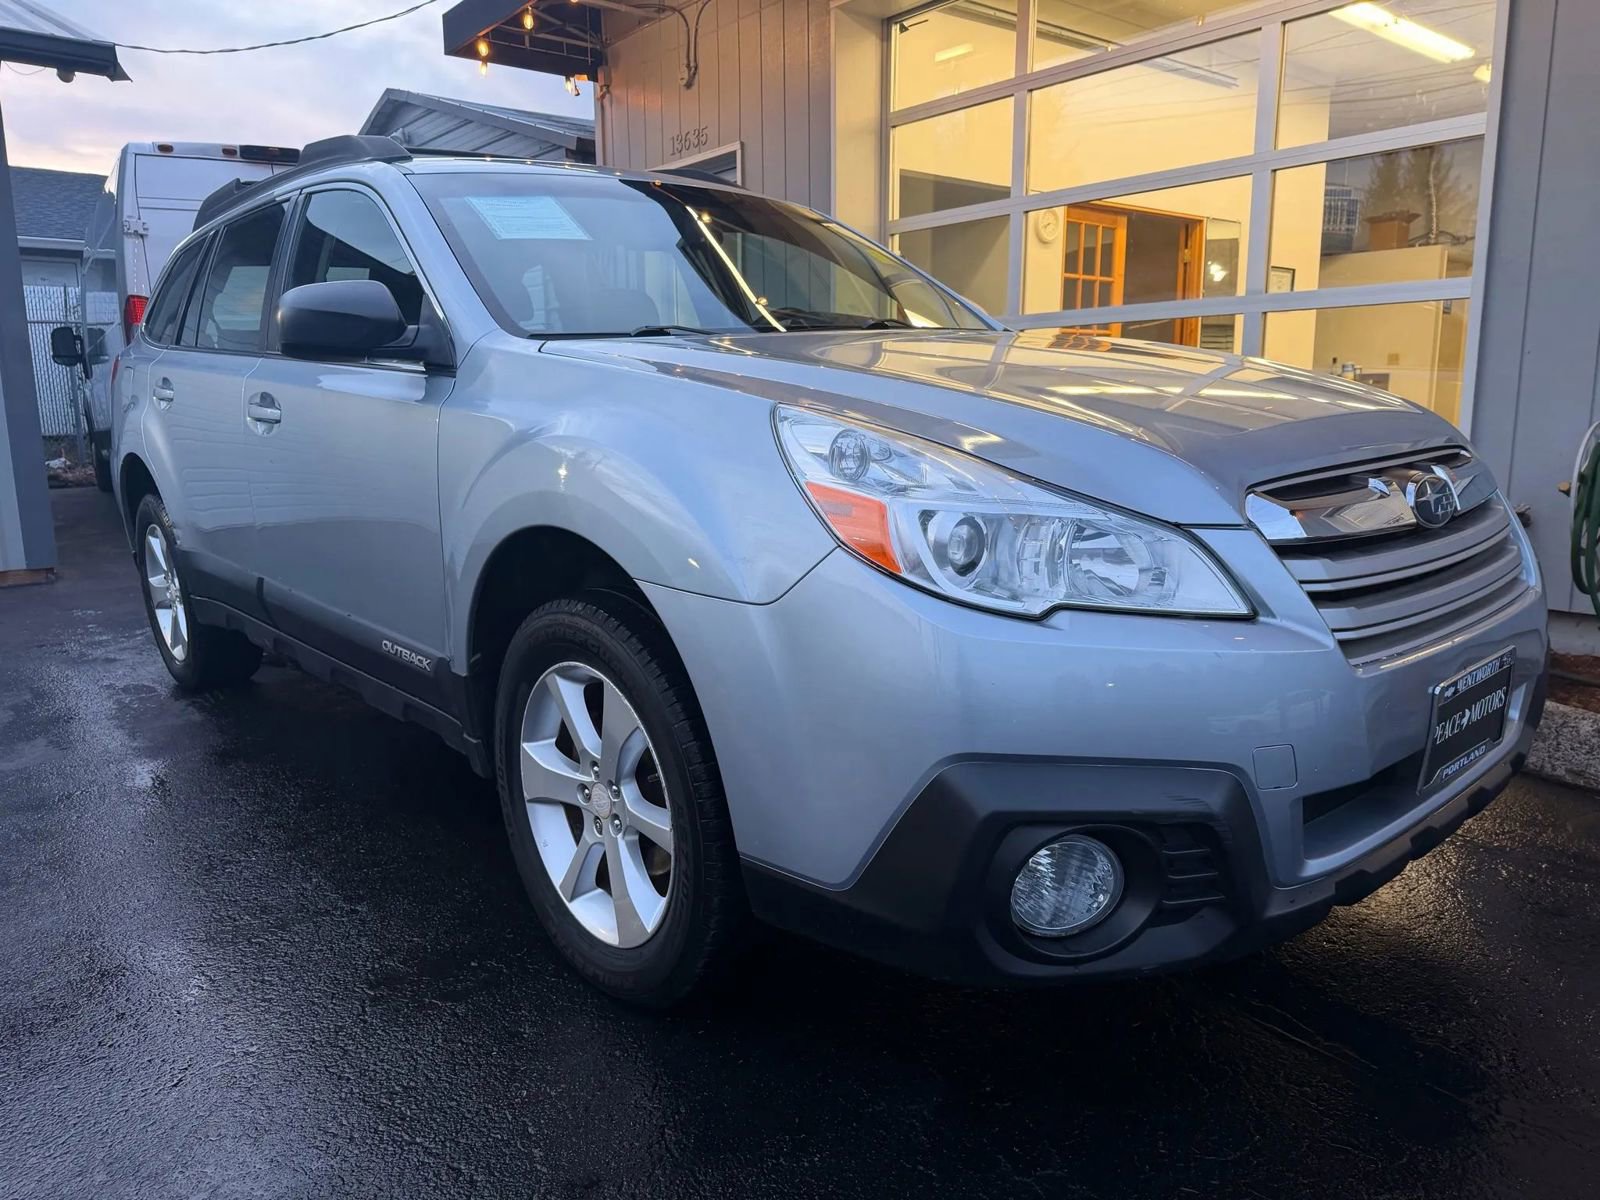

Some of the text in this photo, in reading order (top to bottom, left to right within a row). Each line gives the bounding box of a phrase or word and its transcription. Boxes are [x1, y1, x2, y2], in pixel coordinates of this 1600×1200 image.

[670, 126, 708, 156] 13635
[382, 640, 431, 671] OUTBACK
[1457, 658, 1500, 692] WENTWORTH
[1469, 686, 1506, 724] MOTORS
[1442, 745, 1486, 779] PORTLAND
